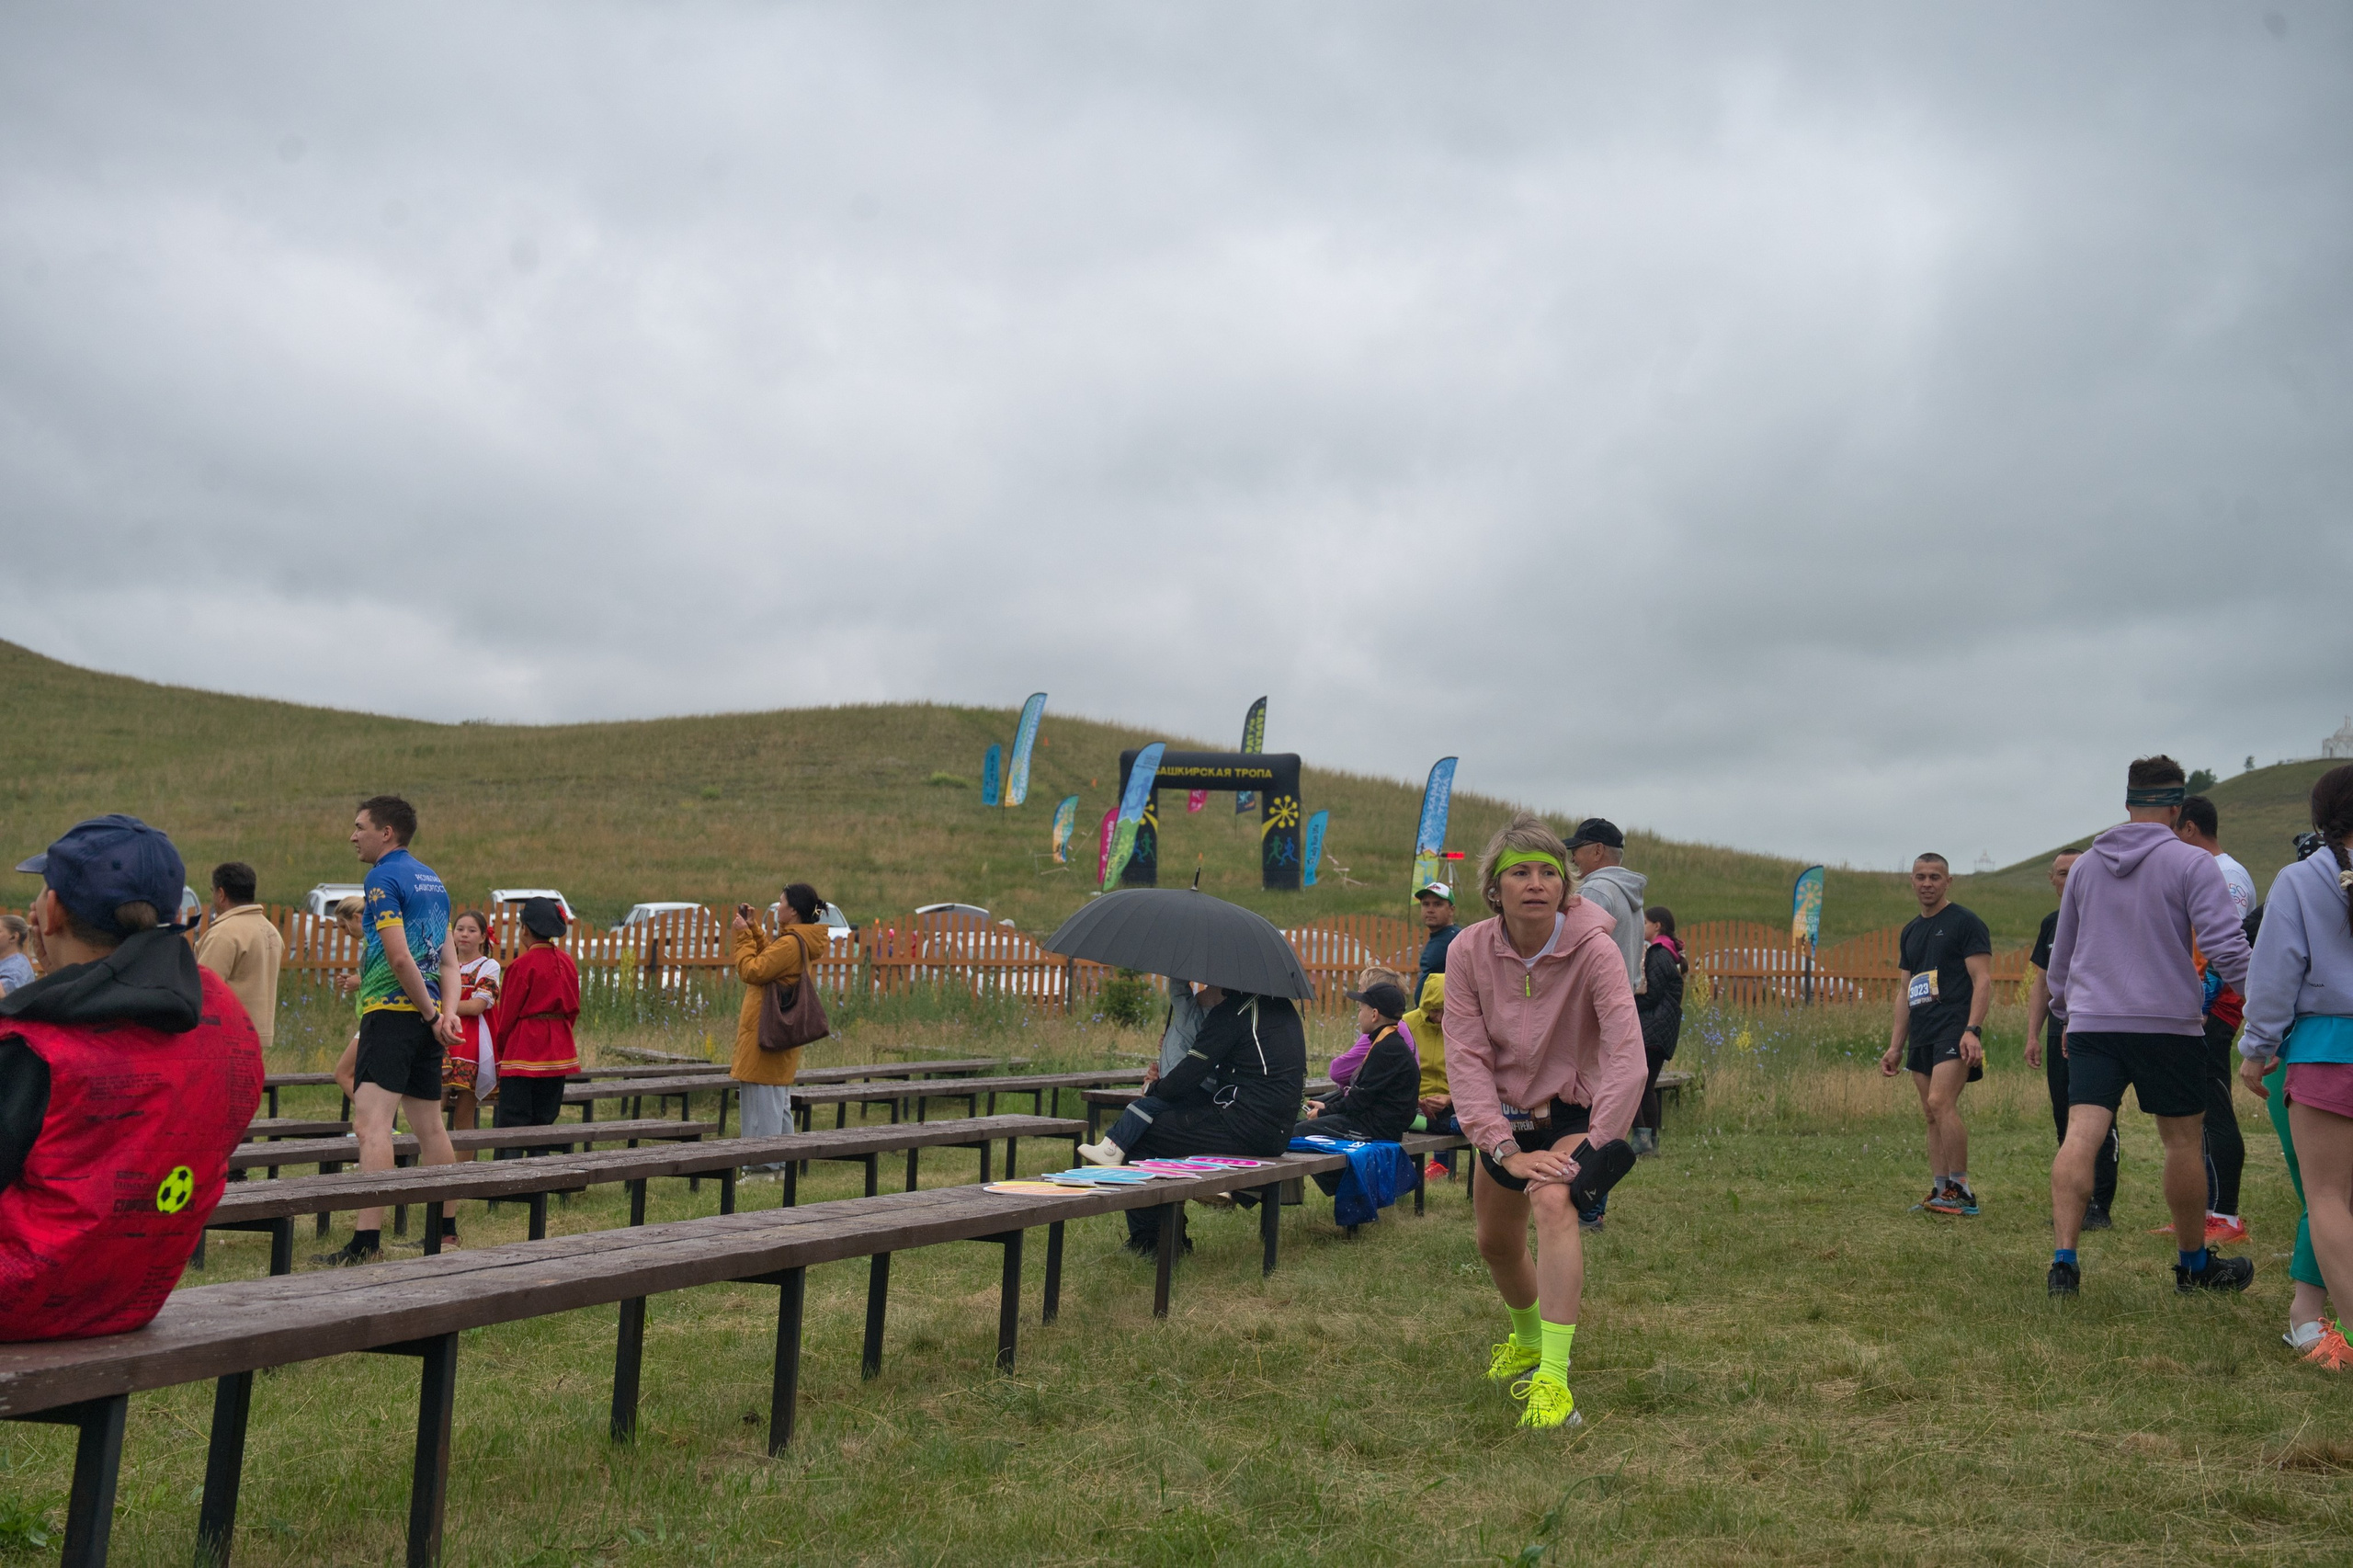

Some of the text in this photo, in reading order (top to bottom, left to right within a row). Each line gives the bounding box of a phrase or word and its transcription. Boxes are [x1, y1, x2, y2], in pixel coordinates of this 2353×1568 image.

[1235, 767, 1273, 778] ТРОПА
[1795, 915, 1820, 924] BASH
[1910, 983, 1929, 999] 3023
